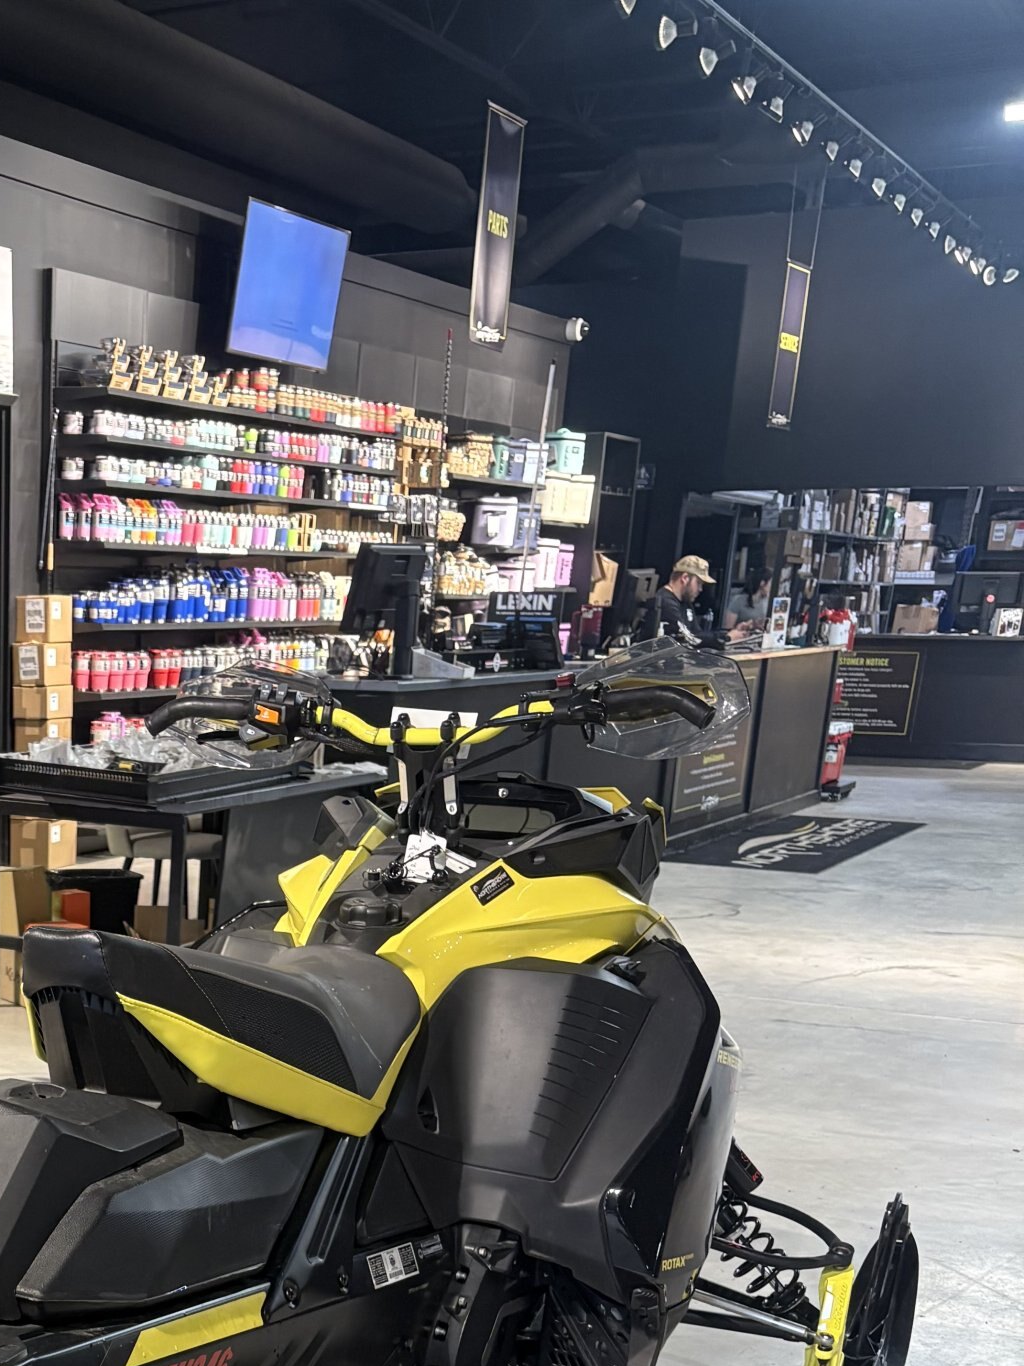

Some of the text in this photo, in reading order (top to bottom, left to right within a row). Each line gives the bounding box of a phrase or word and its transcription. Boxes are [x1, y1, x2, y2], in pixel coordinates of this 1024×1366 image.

[487, 209, 509, 239] PARTS
[496, 593, 553, 611] LEXIN
[661, 1256, 686, 1272] ROTAX
